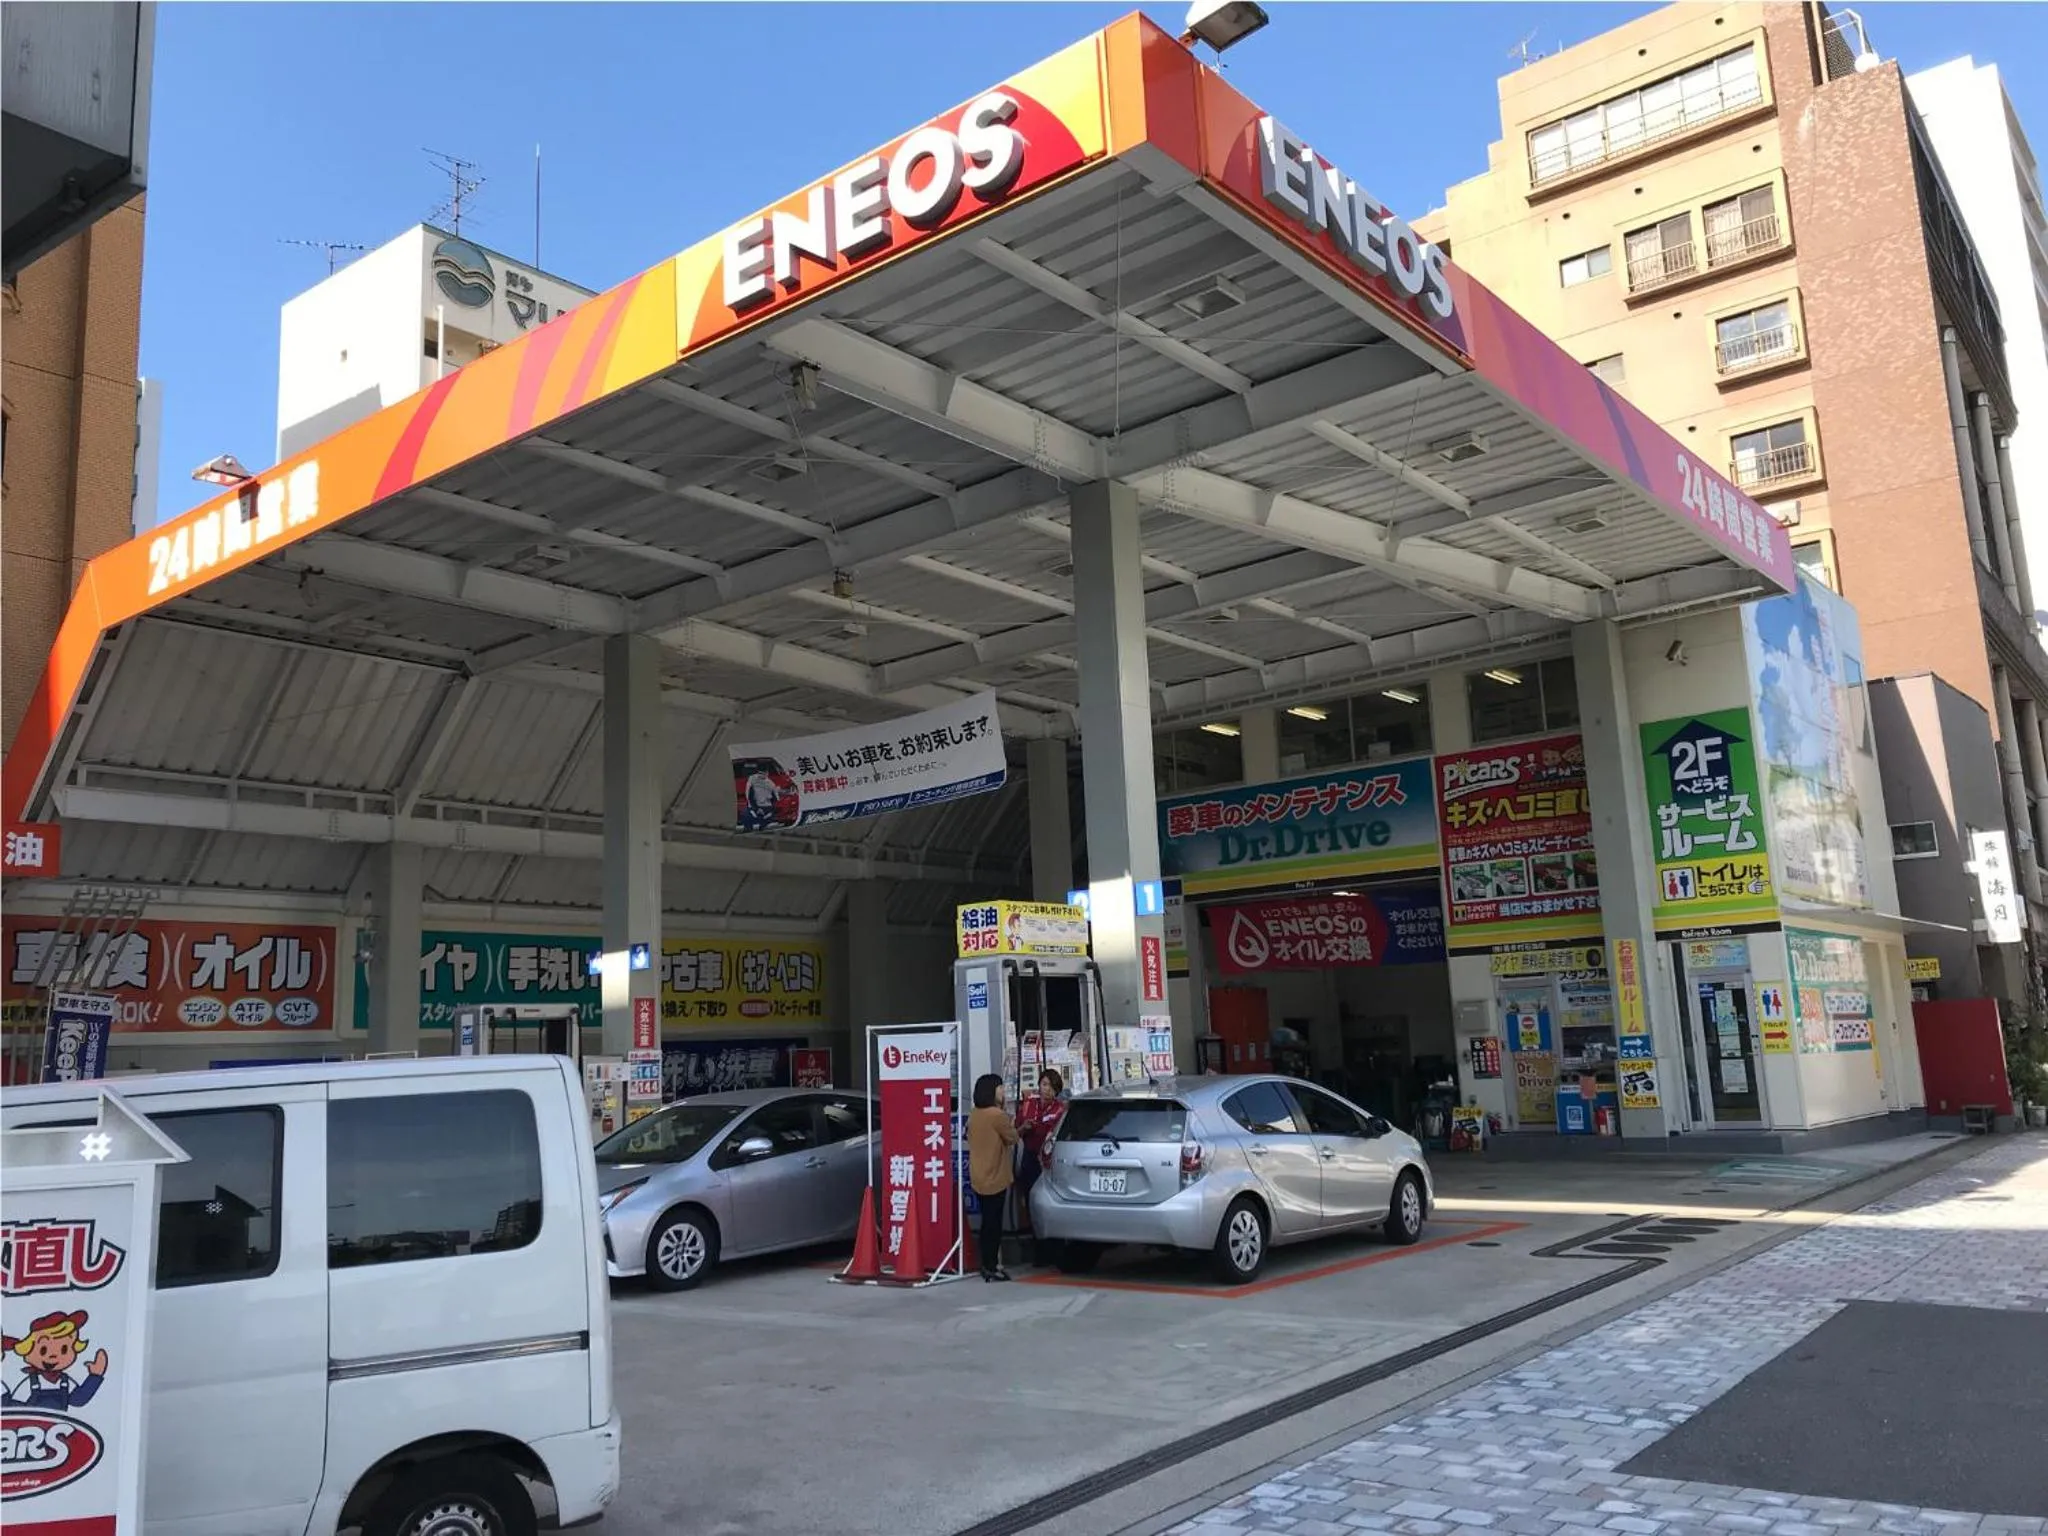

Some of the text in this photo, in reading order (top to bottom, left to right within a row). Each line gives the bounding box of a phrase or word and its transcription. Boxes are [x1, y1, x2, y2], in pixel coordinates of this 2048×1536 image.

[722, 91, 1026, 311] ENEOS
[1259, 116, 1453, 320] ENEOS
[797, 715, 994, 776] 美しいお車を、お約束します。
[1672, 737, 1723, 780] 2F
[1677, 775, 1729, 794] へどうぞ
[1168, 773, 1408, 838] 愛車のメンテナンス
[1657, 794, 1754, 827] サービス
[4, 832, 44, 867] 油
[1218, 816, 1392, 866] Dr.Drive
[1661, 820, 1758, 859] ルーム
[1697, 863, 1764, 884] トイレは
[1143, 884, 1155, 912] 1
[1698, 883, 1745, 897] こちらです
[962, 907, 998, 929] 給油
[1265, 915, 1367, 937] ENEOSの
[962, 930, 999, 951] 対応
[1682, 928, 1732, 939] Refresh Room
[1274, 936, 1373, 961] オイル交換
[190, 934, 313, 992] オイル
[420, 943, 478, 991] イヤ
[57, 997, 111, 1012] 愛車を守る
[235, 1003, 265, 1012] ATF
[283, 1003, 311, 1012] CVT
[903, 1050, 948, 1066] EneKey
[1517, 1063, 1535, 1073] Dr.
[639, 1081, 659, 1093] 144
[1519, 1076, 1553, 1087] Drive
[923, 1087, 945, 1223] エネキー
[2, 1222, 122, 1293] 直し
